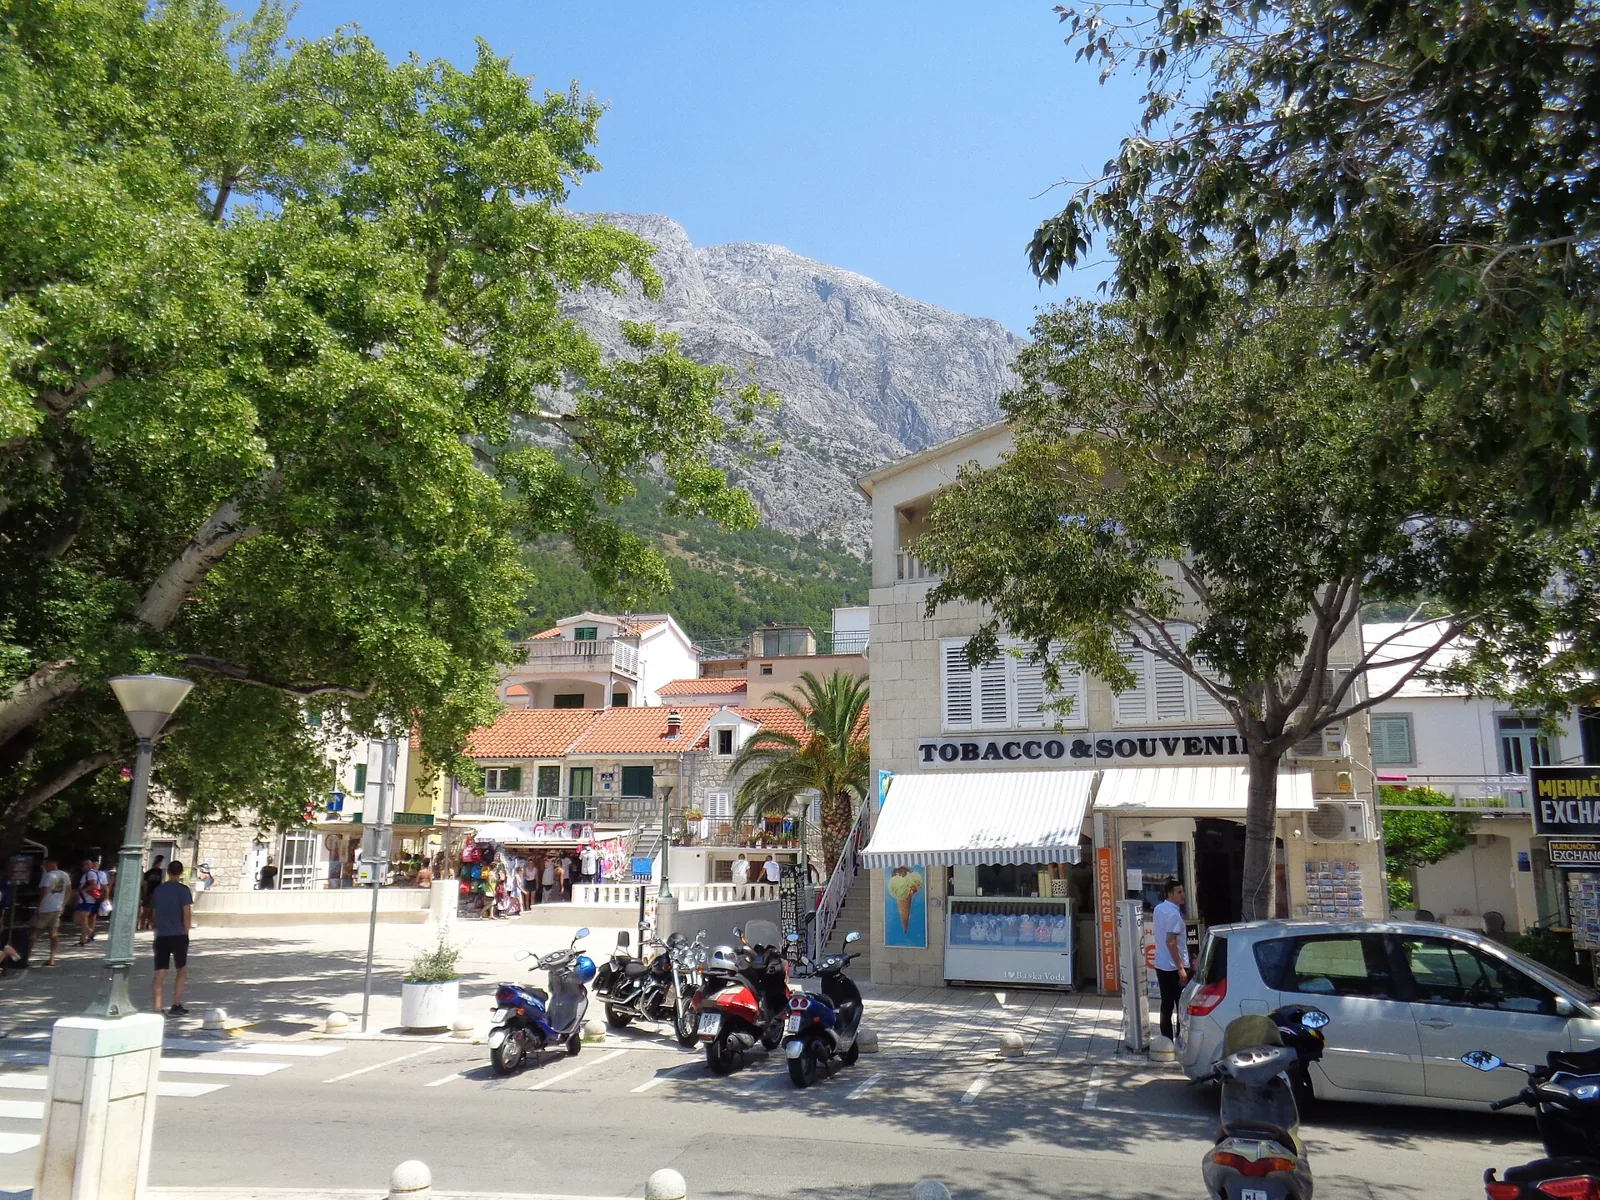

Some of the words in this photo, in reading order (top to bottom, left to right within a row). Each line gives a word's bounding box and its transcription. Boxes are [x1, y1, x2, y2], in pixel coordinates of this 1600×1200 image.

[918, 740, 1065, 763] TOBACCO
[1095, 735, 1249, 759] SOUVENI
[1100, 859, 1111, 922] EXCHANGE
[1103, 931, 1114, 979] OFFICE
[1044, 972, 1065, 981] Voda
